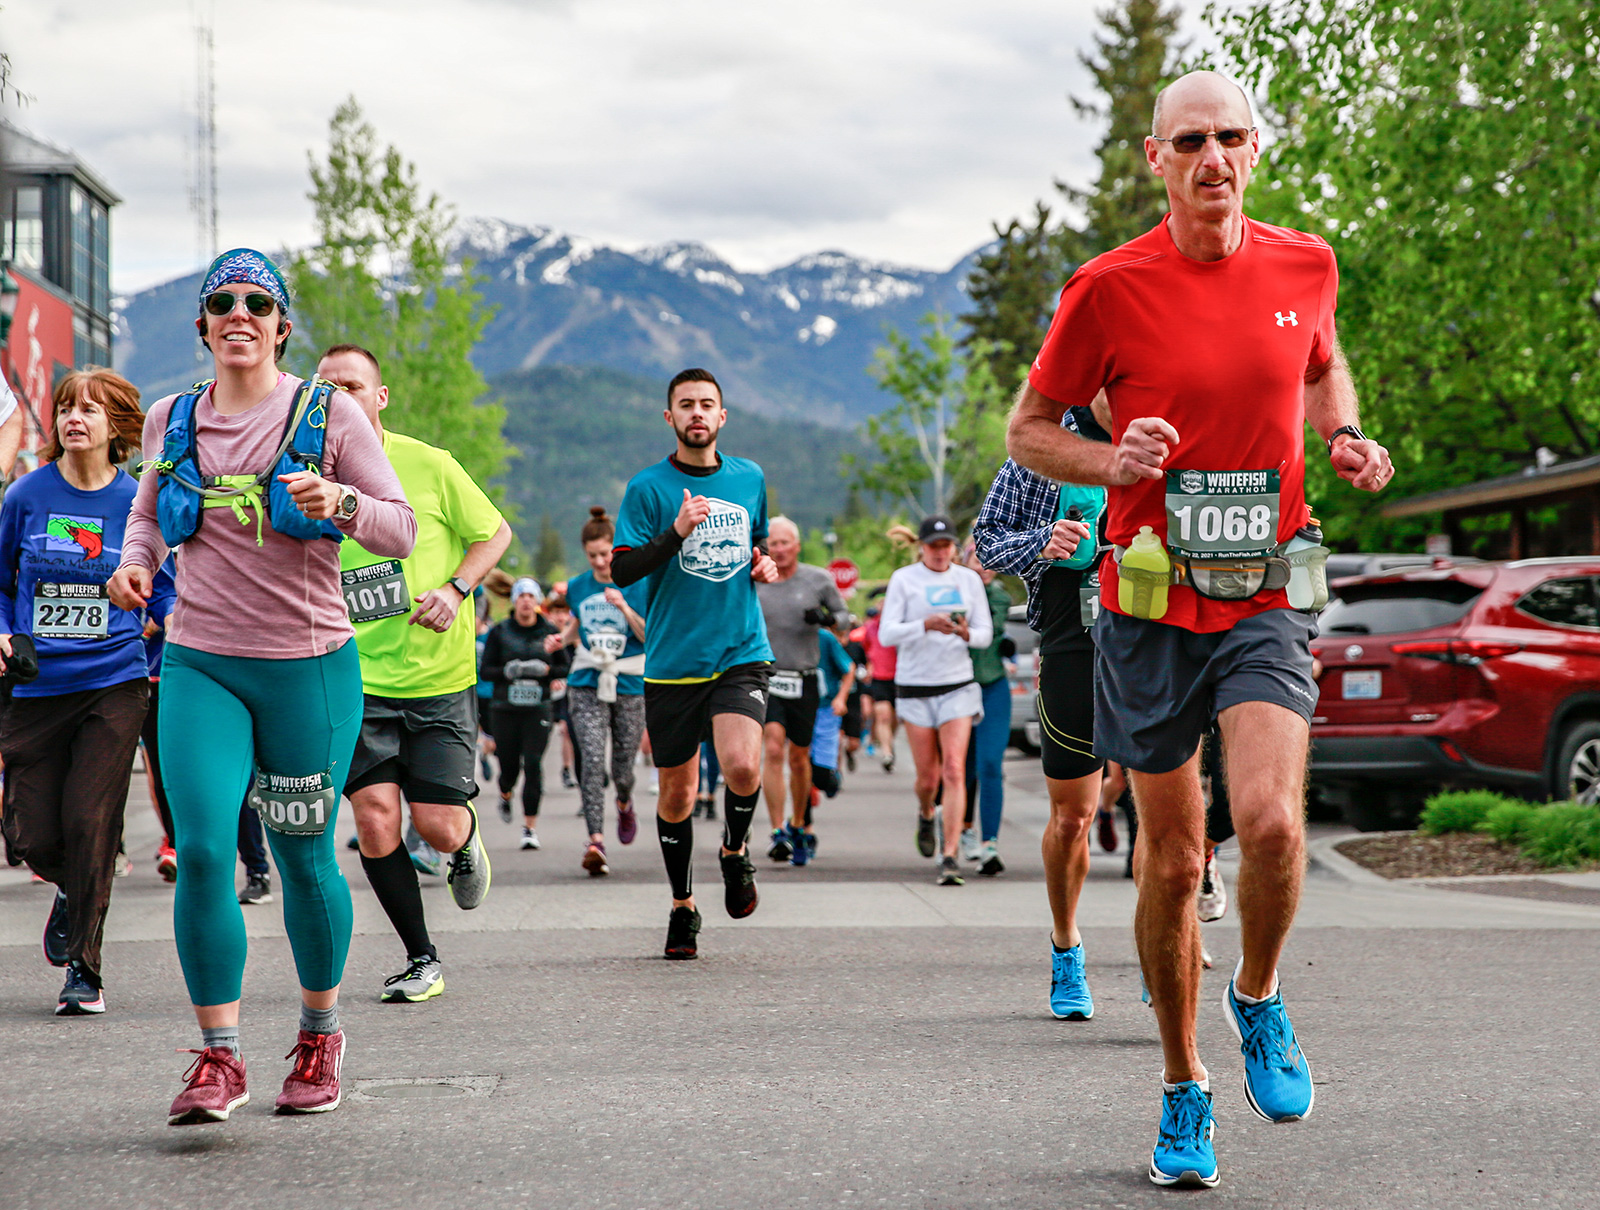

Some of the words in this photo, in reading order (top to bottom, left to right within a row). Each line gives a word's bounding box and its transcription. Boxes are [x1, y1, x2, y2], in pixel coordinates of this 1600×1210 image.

[1206, 472, 1267, 487] WHITEFISH
[1174, 504, 1271, 542] 1068
[1181, 549, 1191, 558] May
[355, 561, 394, 578] WHITEFISH
[358, 570, 394, 581] MARATHON
[59, 583, 100, 595] WHITEFISH
[346, 580, 402, 613] 1017
[37, 603, 104, 629] 2278
[269, 772, 322, 788] WHITEFISH
[271, 784, 323, 793] MARATHON
